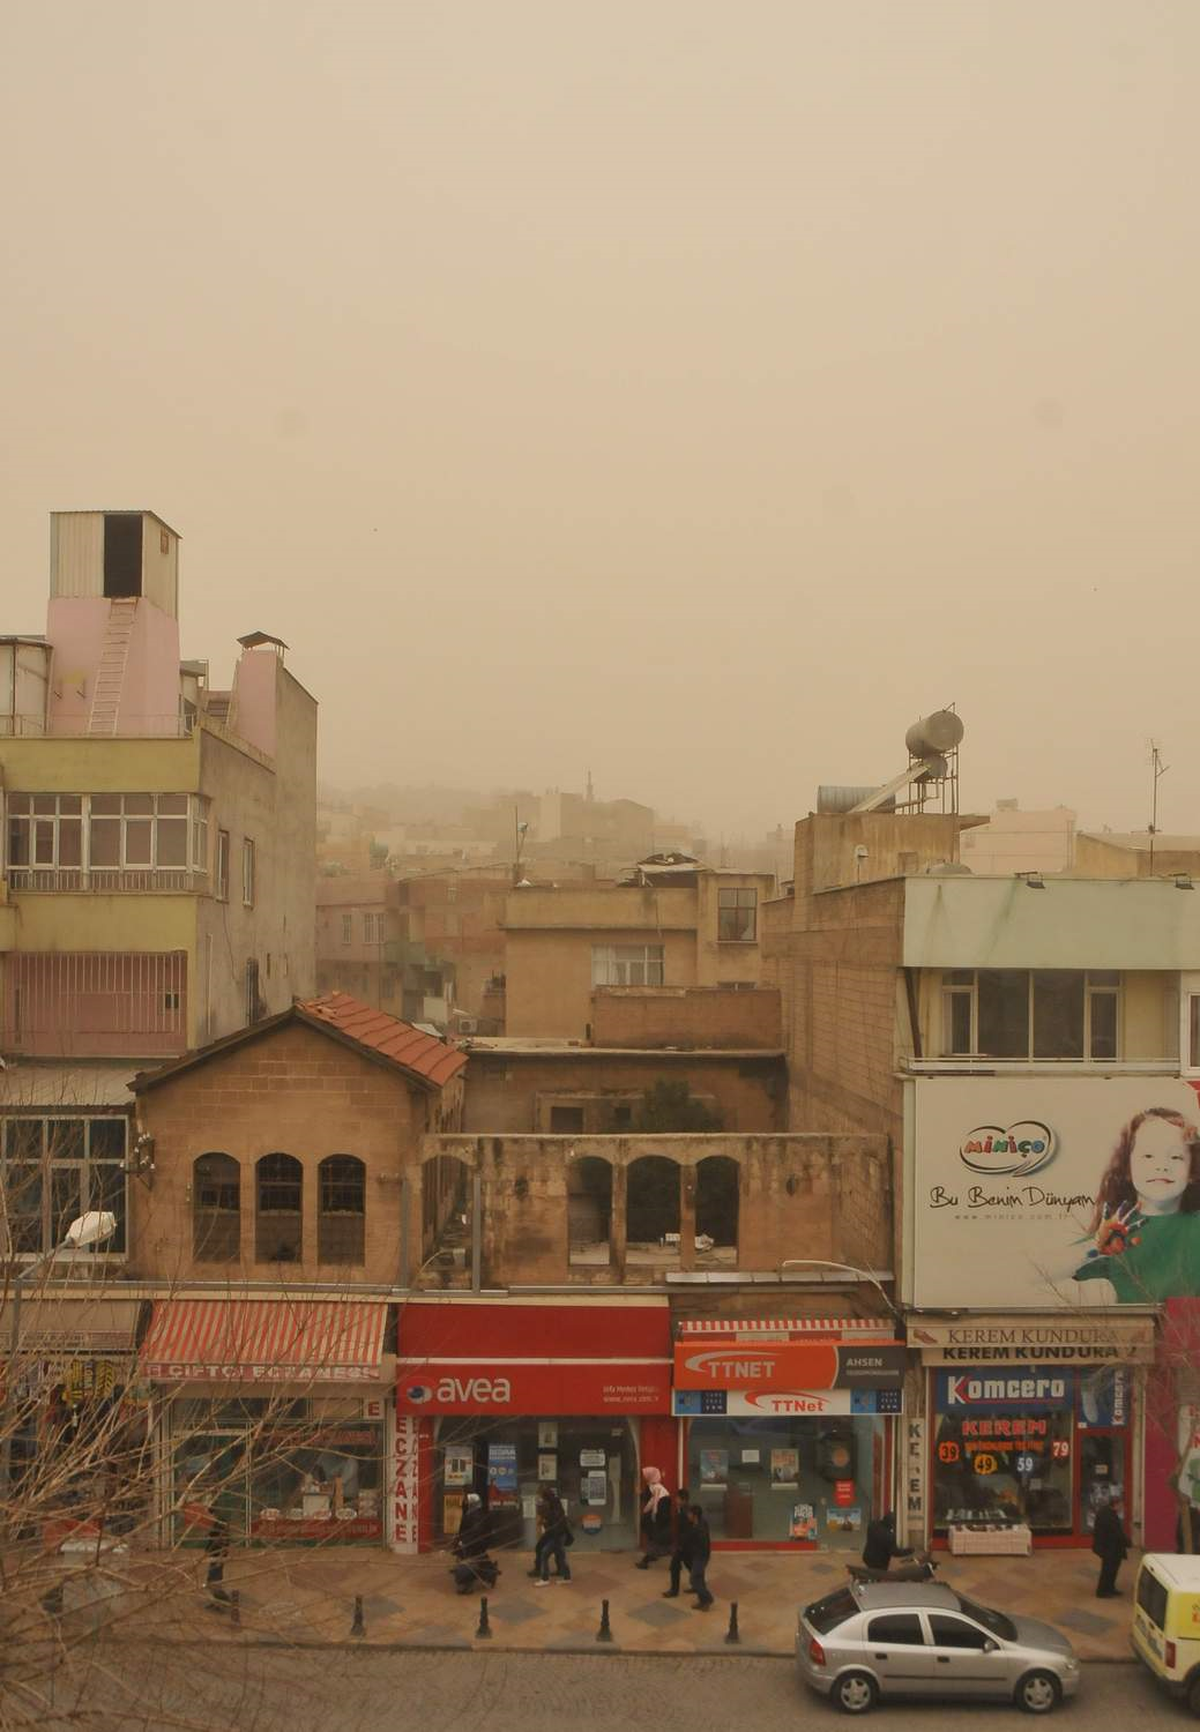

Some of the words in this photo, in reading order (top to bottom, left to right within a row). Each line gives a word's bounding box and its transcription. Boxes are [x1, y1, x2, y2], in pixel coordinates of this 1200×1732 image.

[930, 1185, 958, 1208] Bu
[968, 1185, 1023, 1208] Benim
[948, 1329, 1014, 1344] KEREM
[1021, 1329, 1120, 1343] KUNDURA
[943, 1347, 1010, 1359] KEREM
[1015, 1346, 1119, 1359] KUNDURA
[708, 1361, 776, 1378] TTNET
[846, 1357, 883, 1367] AHSEN
[436, 1377, 511, 1402] avea
[947, 1376, 1065, 1404] Komcero
[771, 1400, 824, 1412] TTNet
[962, 1420, 1047, 1436] KEREM
[1053, 1441, 1069, 1457] 79
[976, 1457, 992, 1471] 49
[1016, 1457, 1034, 1471] 59
[395, 1416, 408, 1542] ECZANE
